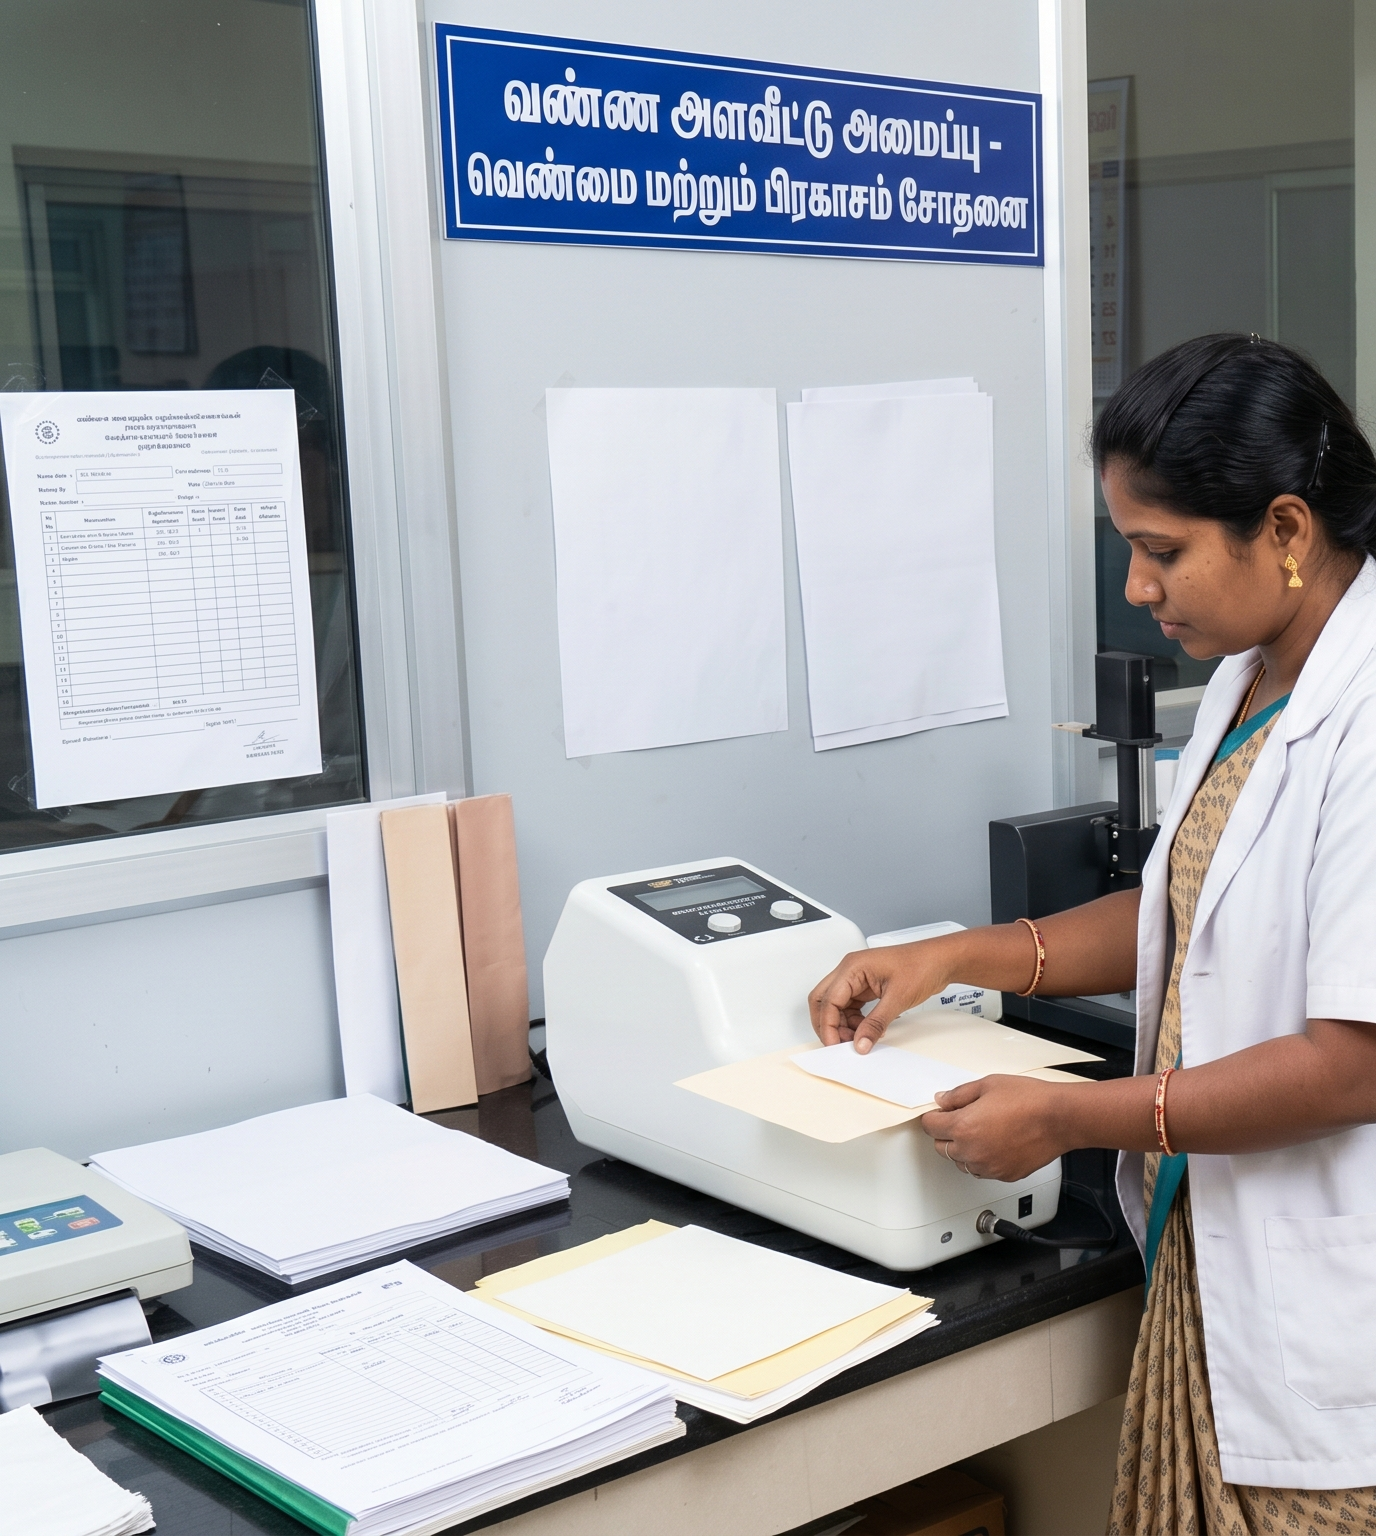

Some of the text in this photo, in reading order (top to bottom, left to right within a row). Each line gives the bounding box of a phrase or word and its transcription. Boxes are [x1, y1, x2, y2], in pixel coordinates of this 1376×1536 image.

[504, 67, 660, 133] வண்ண
[671, 86, 833, 158] அளவீட்டு
[843, 109, 980, 173] அமைப்பு
[468, 147, 1028, 237] வெண்மை மற்றும் பிரகாசம் சோதனை
